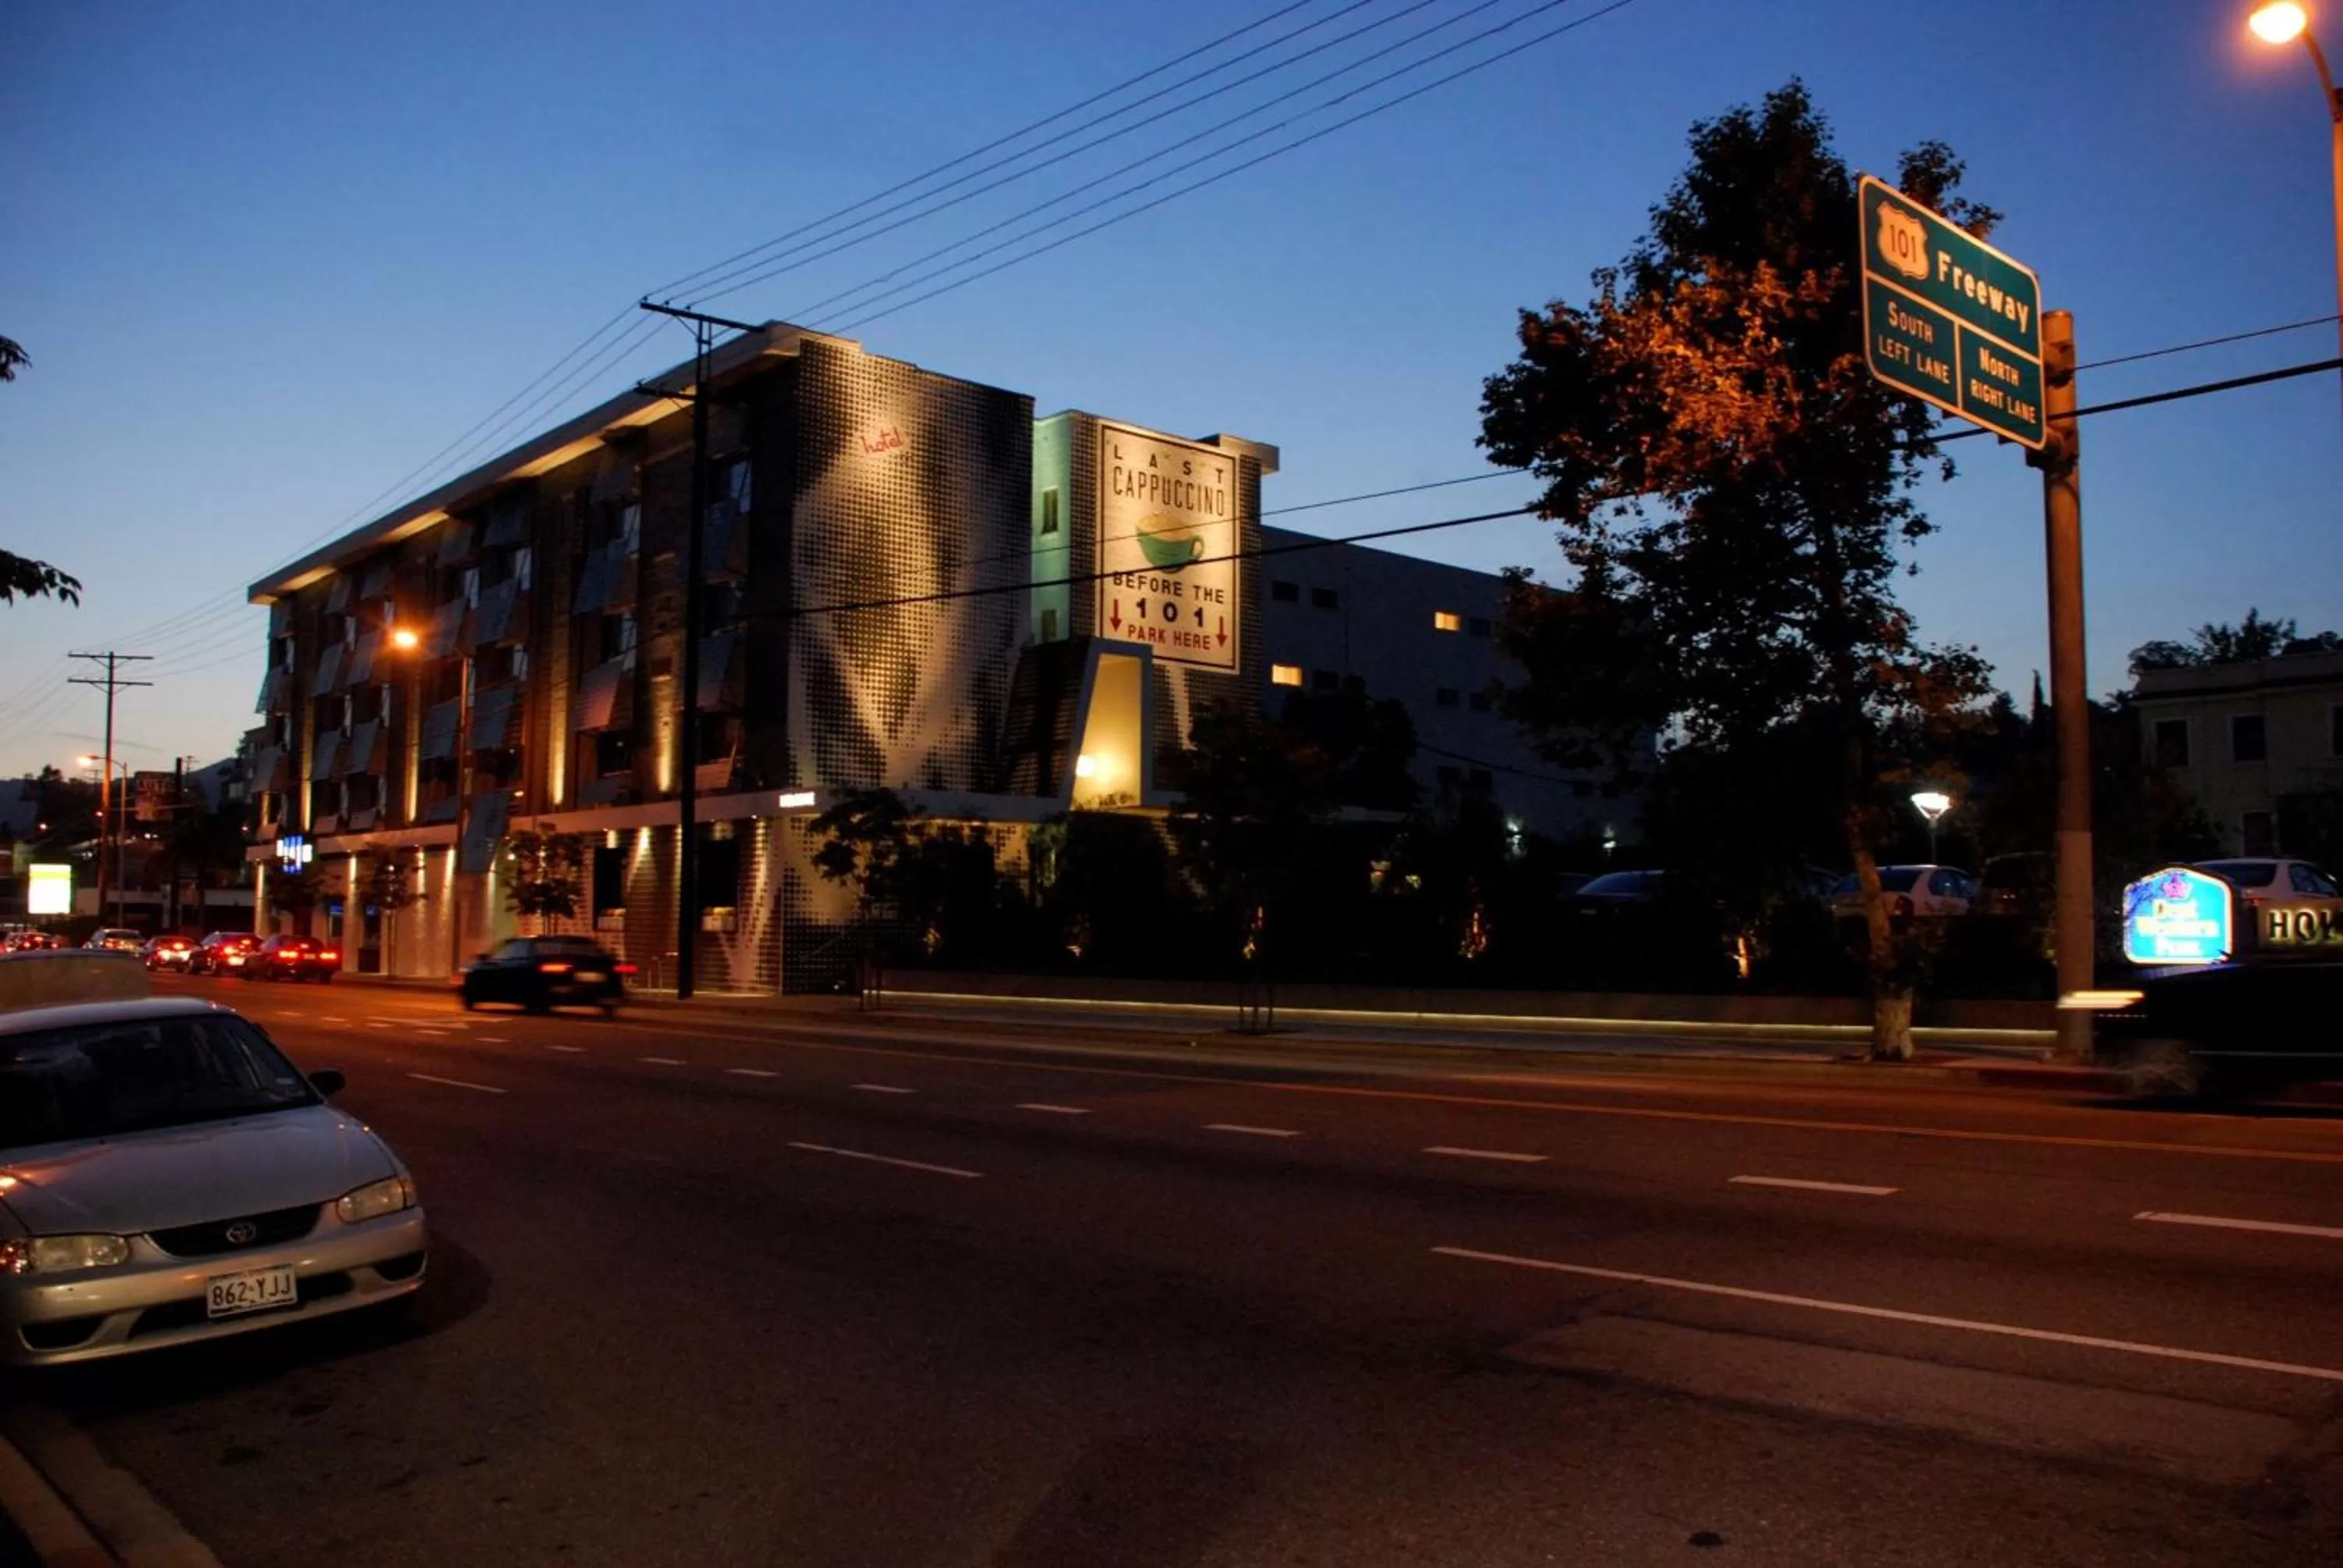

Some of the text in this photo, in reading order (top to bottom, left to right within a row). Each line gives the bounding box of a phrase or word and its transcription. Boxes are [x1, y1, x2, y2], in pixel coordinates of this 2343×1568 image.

[1890, 224, 1917, 263] 101
[1937, 250, 2029, 333] Freeway
[1887, 299, 1934, 344] SOUTH
[1878, 334, 1950, 385] LEFT LANE
[1979, 347, 2020, 387] NORTH
[1970, 377, 2038, 426] RIGHT LANE
[861, 426, 903, 454] hotel
[1114, 444, 1224, 483] LAST
[1113, 465, 1224, 516] CAPPUCCINO
[1113, 572, 1224, 604] BEFORE THE
[1136, 597, 1204, 627] 101
[1128, 624, 1211, 650] PARK HERE
